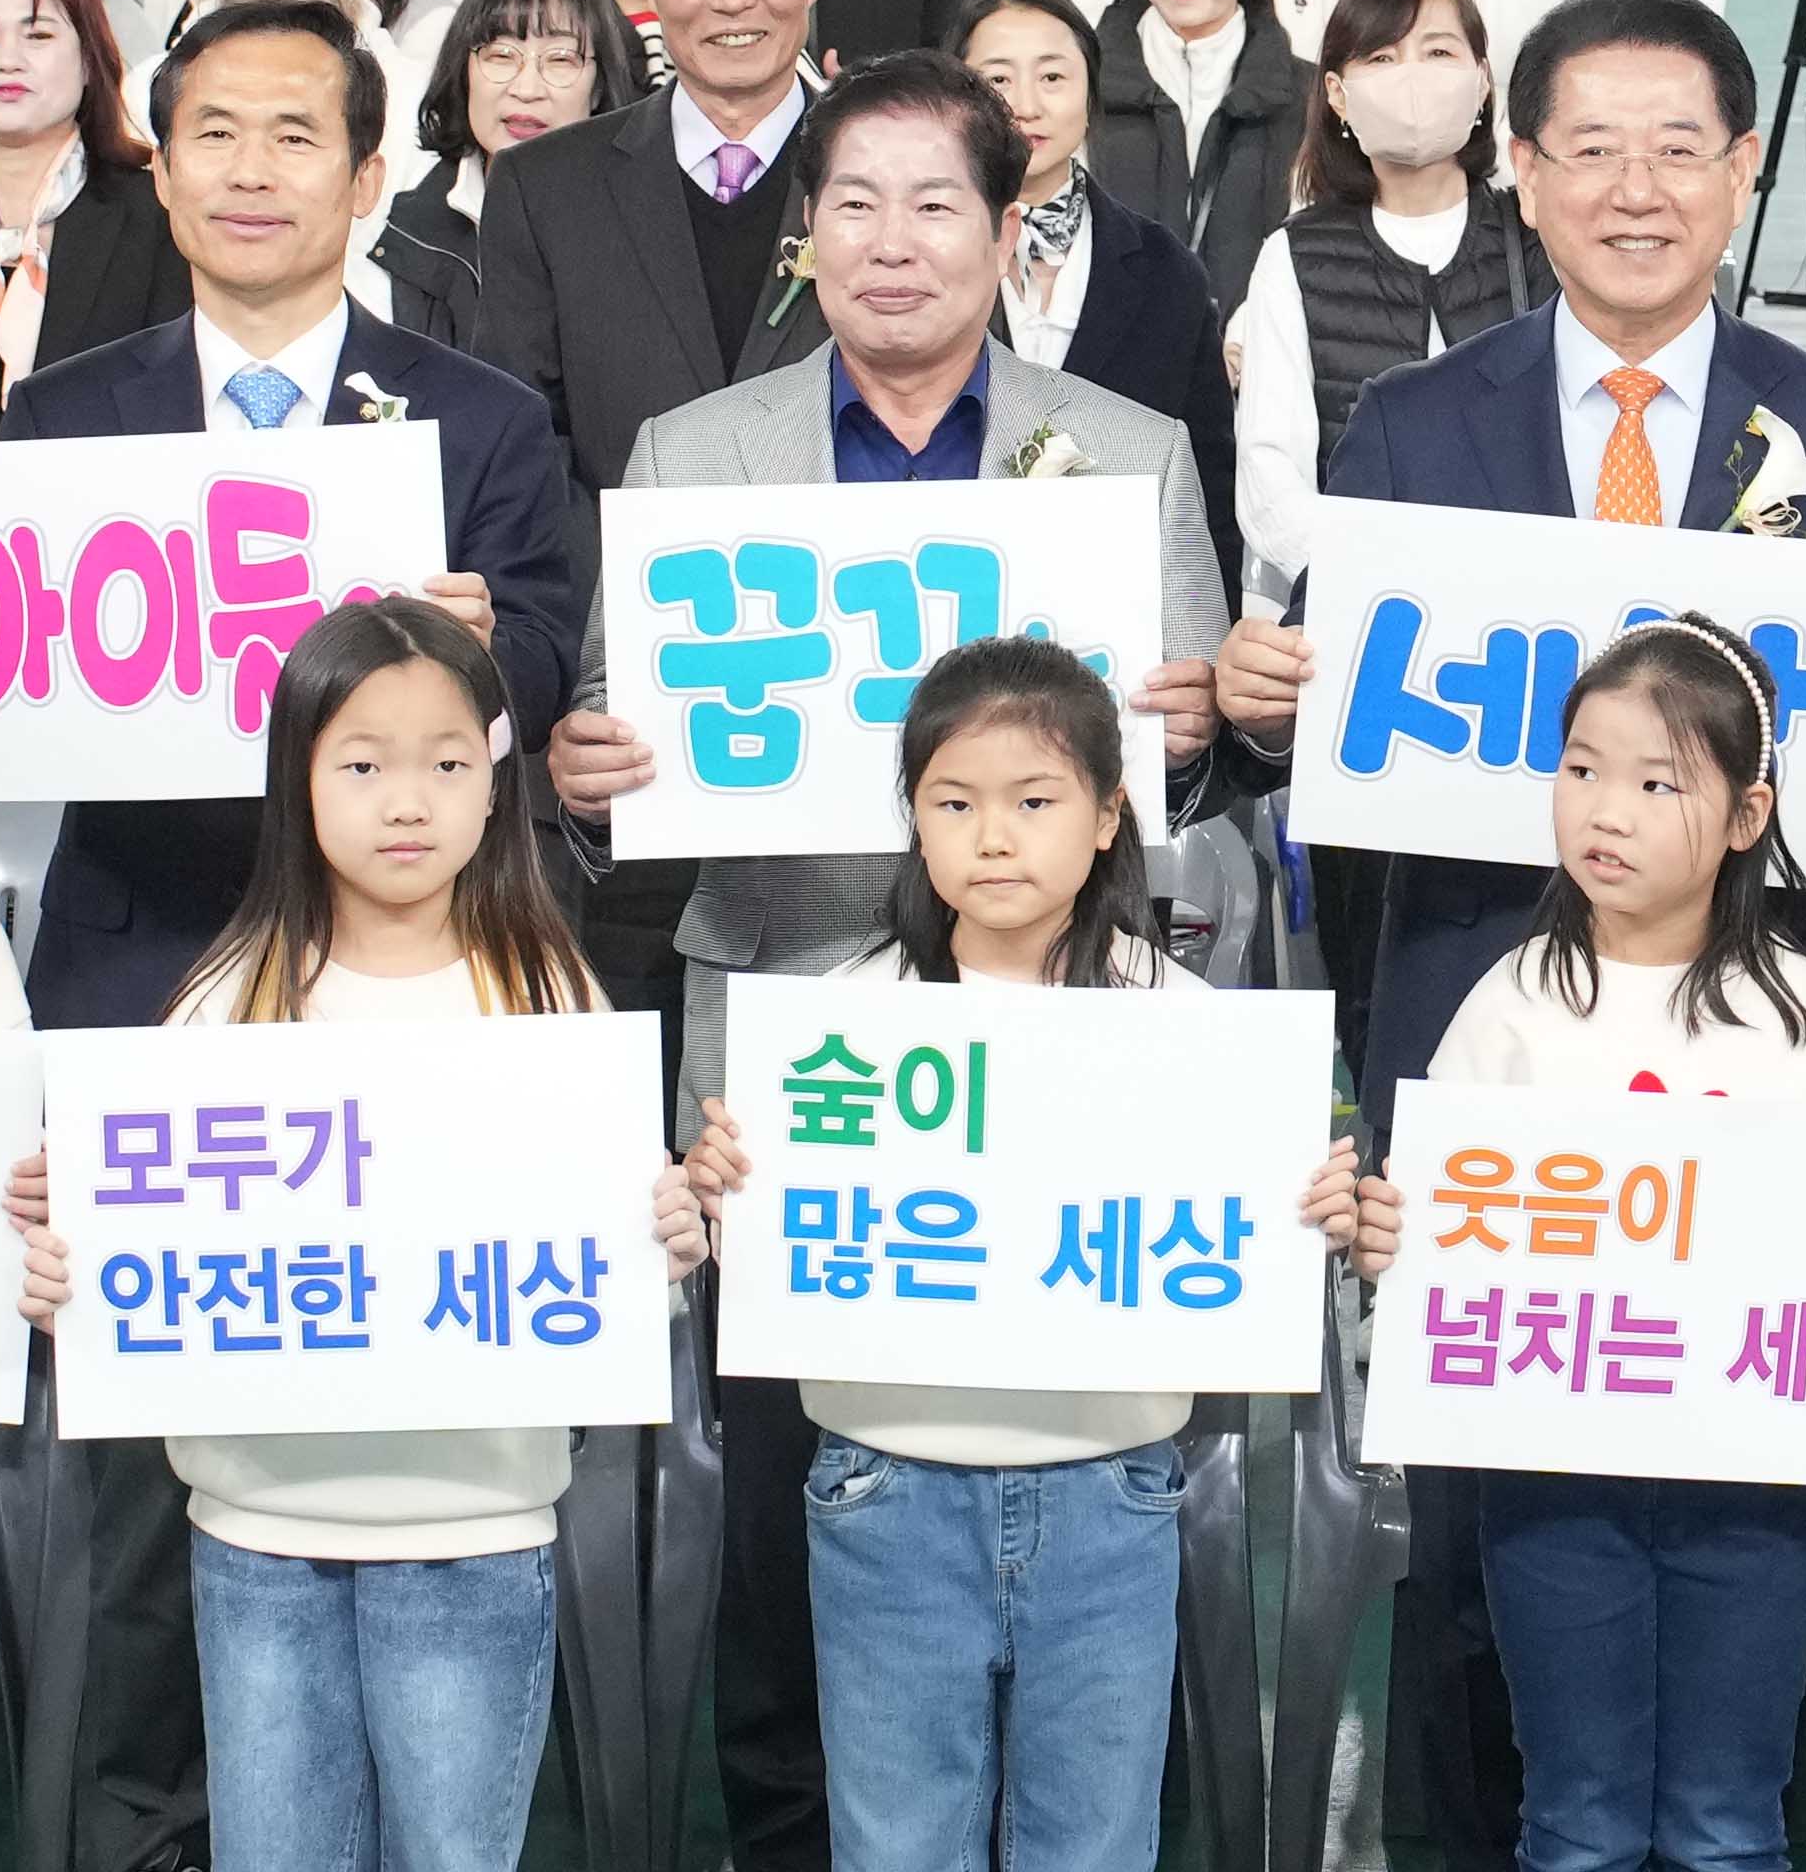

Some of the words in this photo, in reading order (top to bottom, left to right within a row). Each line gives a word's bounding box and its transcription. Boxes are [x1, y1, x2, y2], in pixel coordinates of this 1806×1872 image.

[782, 1033, 988, 1154] 숲이
[94, 1098, 372, 1212] 모두가
[1433, 1148, 1698, 1263] 웃음이
[99, 1243, 378, 1355] 안전한
[424, 1236, 610, 1348] 세상
[782, 1185, 988, 1302] 많은
[1041, 1195, 1256, 1312] 세상
[1425, 1287, 1685, 1395] 넘치는
